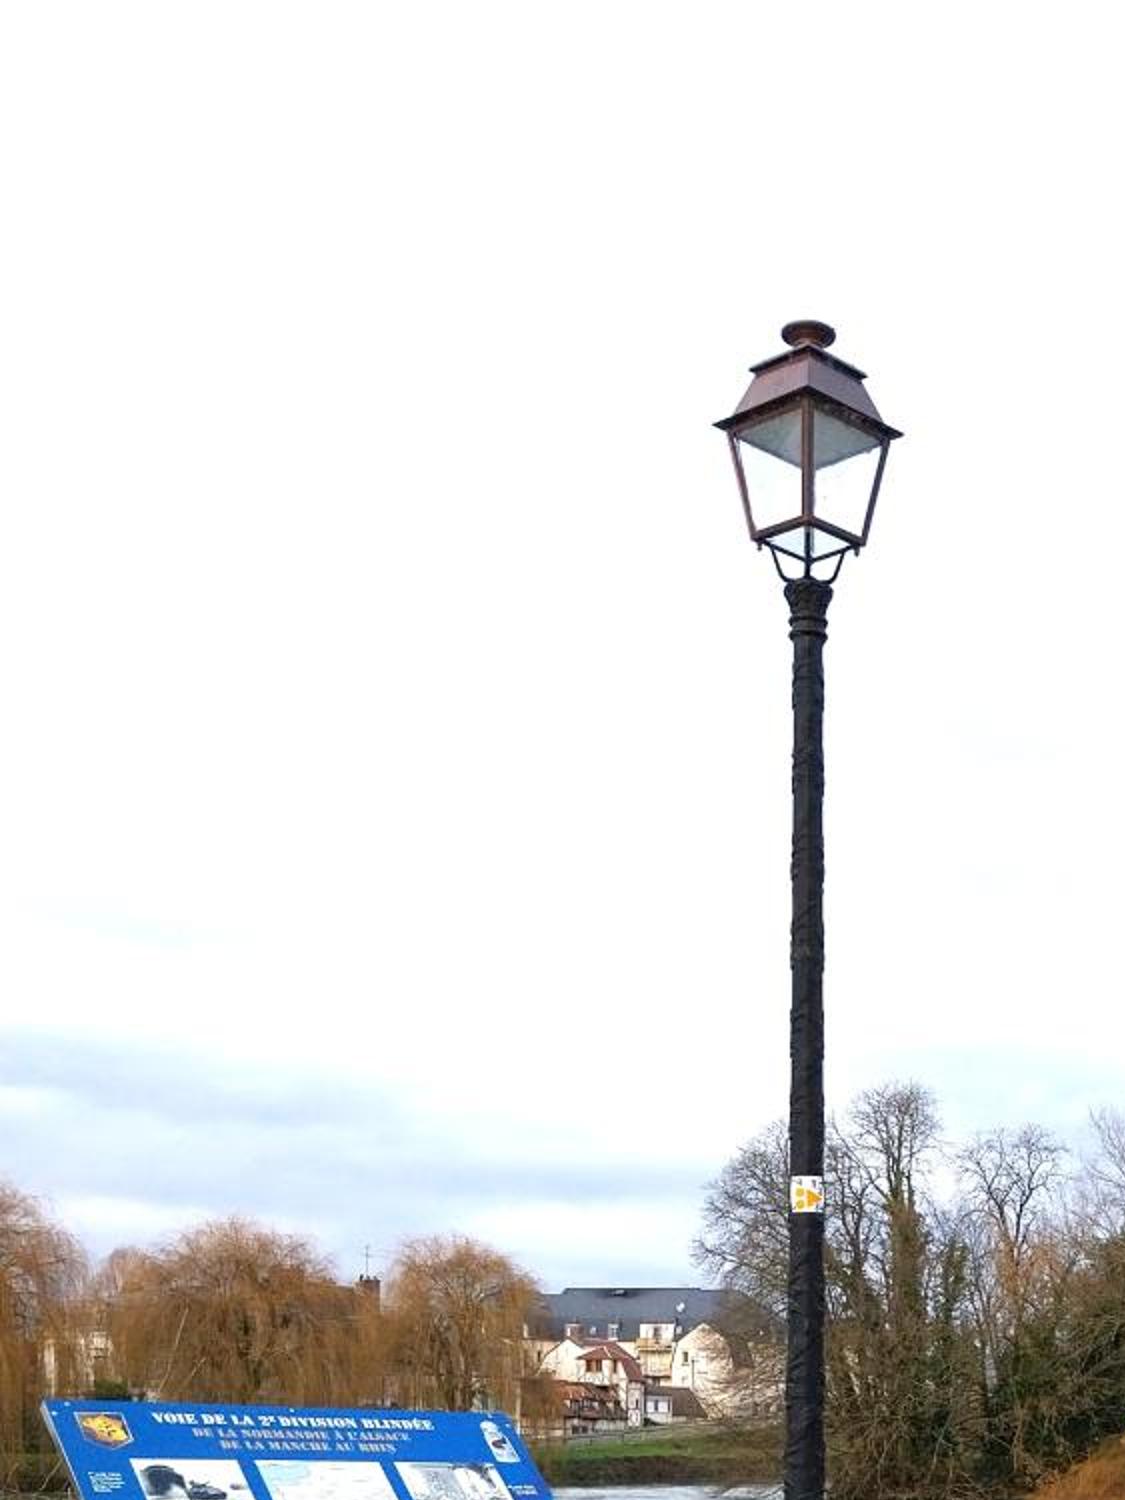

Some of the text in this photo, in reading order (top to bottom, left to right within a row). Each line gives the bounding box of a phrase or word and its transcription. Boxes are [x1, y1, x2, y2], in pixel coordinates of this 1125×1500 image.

[151, 1411, 199, 1425] VOIE
[201, 1413, 227, 1425] DE
[230, 1413, 255, 1426] LA
[278, 1415, 358, 1429] DIVISION
[360, 1417, 436, 1431] BLINDÉE
[192, 1427, 215, 1438] DE
[217, 1428, 239, 1439] LA
[240, 1429, 331, 1440] NORMANDIE
